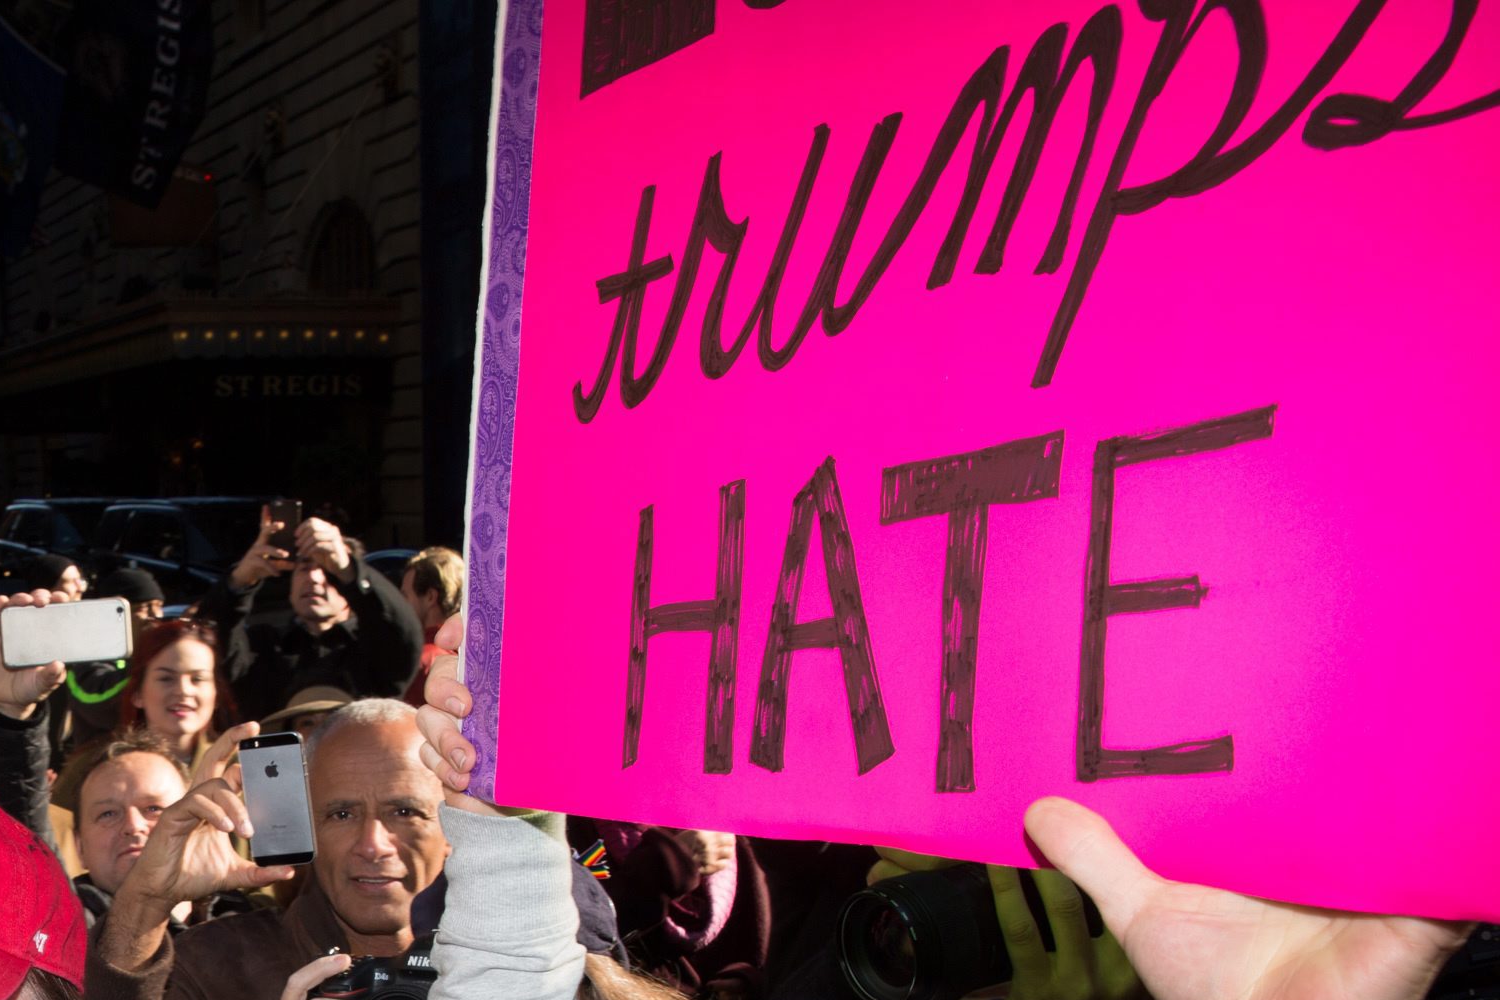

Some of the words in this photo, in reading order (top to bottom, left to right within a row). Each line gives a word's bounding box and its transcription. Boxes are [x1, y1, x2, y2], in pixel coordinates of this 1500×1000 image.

[213, 373, 254, 398] ST
[261, 373, 364, 398] REGIS
[621, 404, 1278, 793] HATE
[407, 955, 431, 967] Nik
